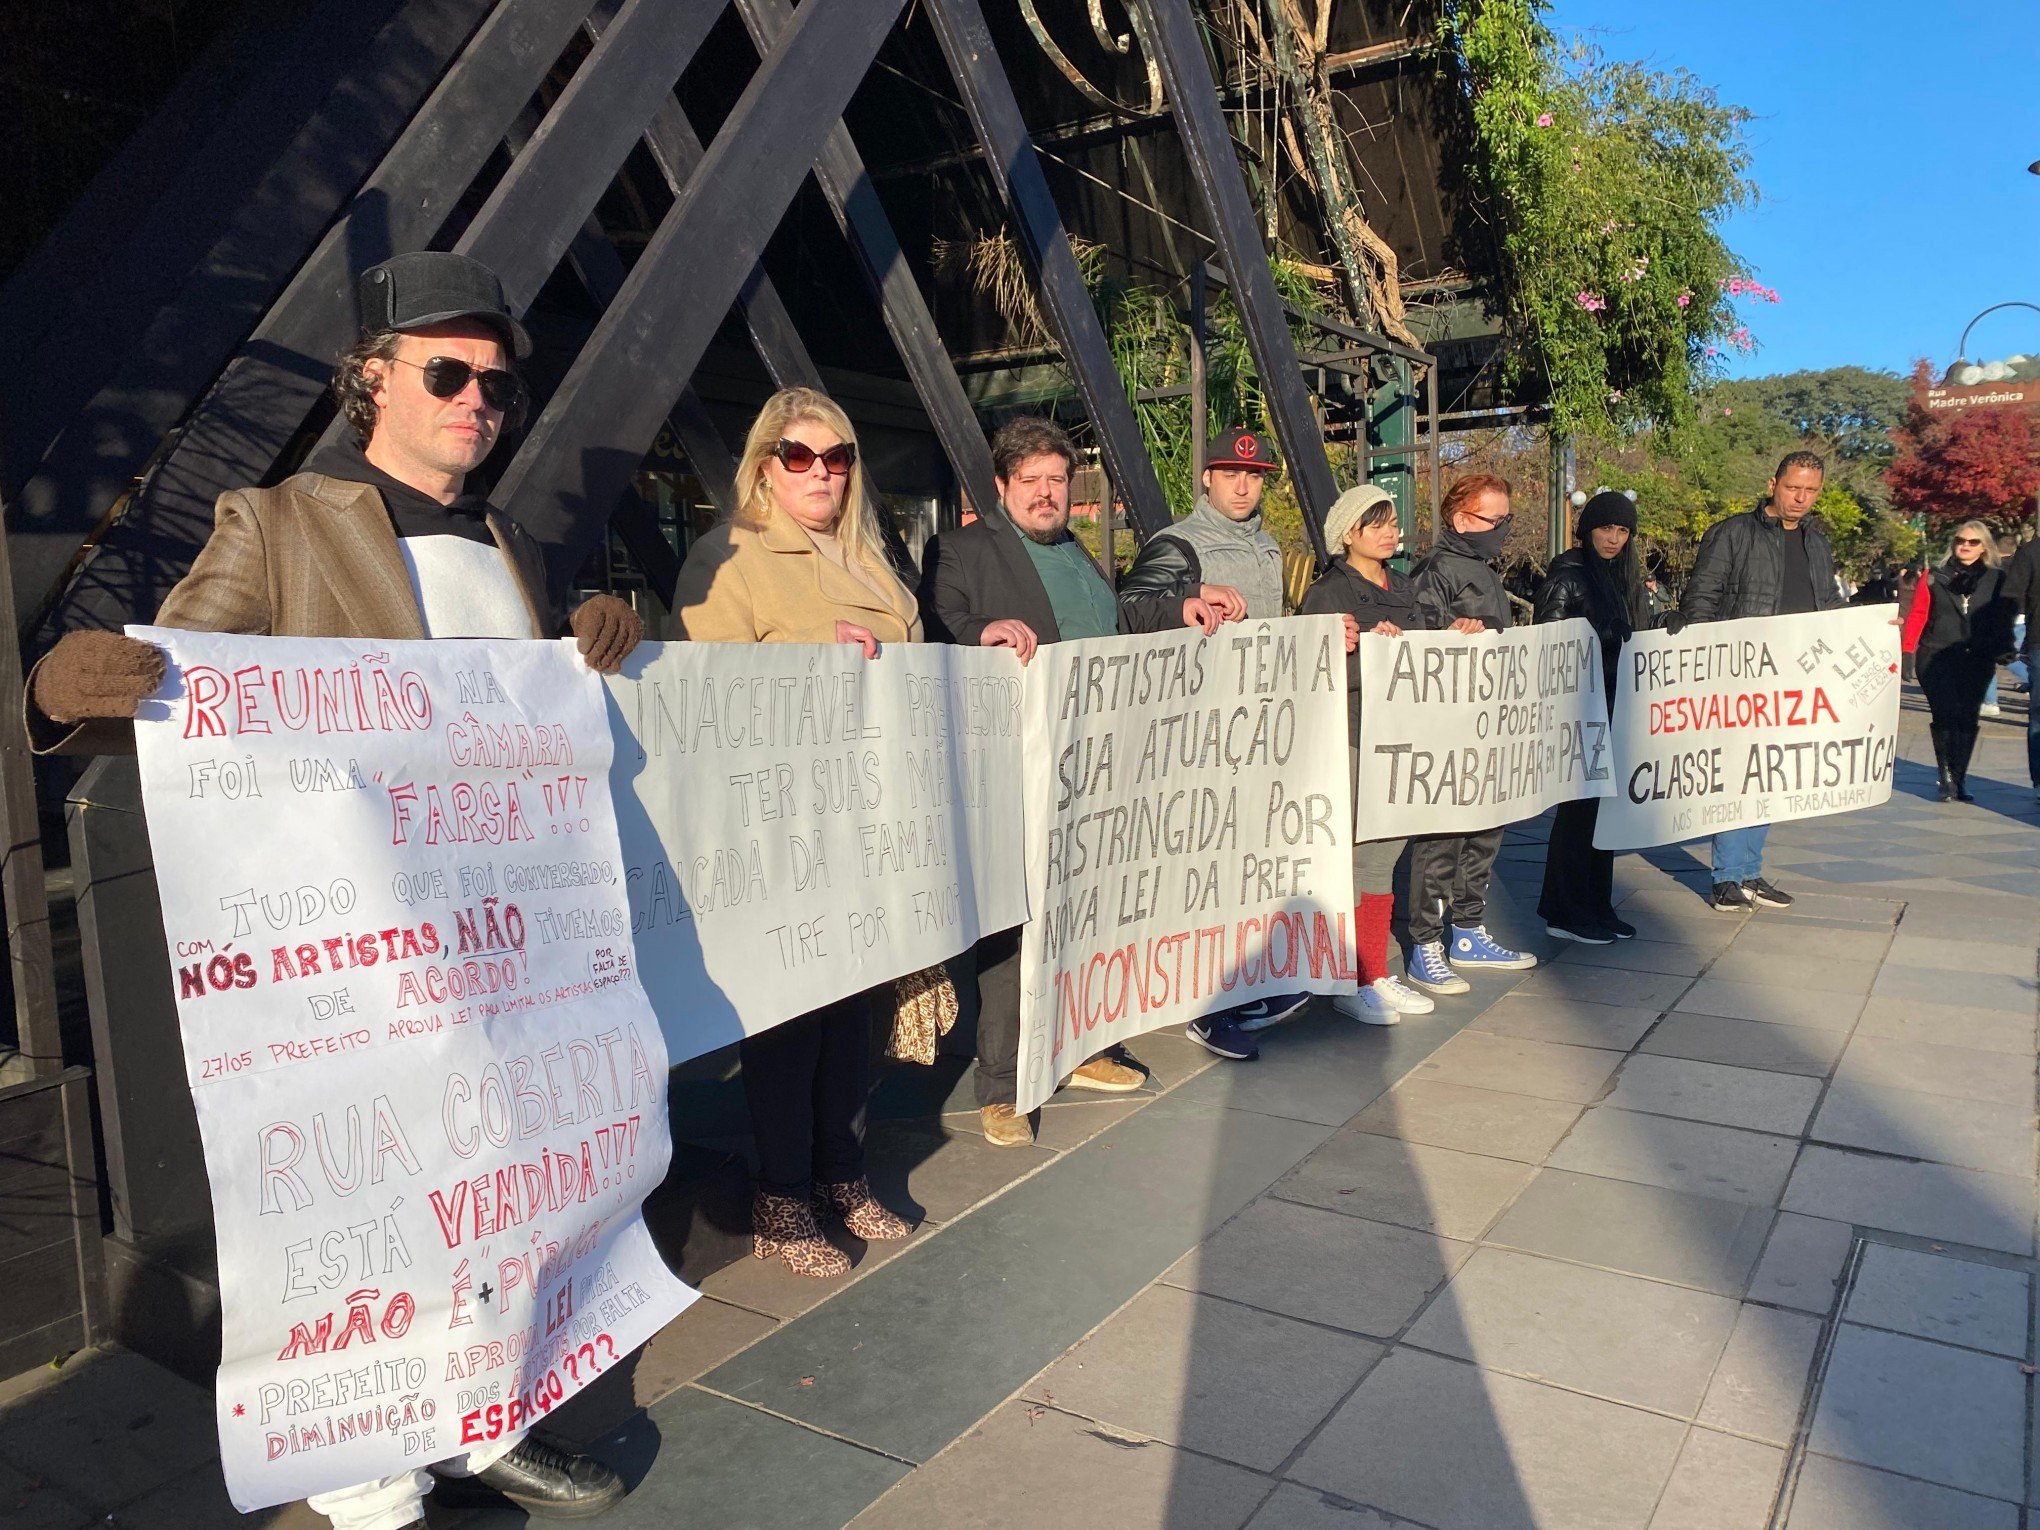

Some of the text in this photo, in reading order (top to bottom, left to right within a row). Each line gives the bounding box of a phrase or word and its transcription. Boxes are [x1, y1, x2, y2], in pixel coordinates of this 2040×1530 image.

[1928, 389, 1946, 397] Rua
[1929, 391, 2023, 408] Madre Verônica
[183, 651, 506, 739] REUNIÃO NA
[1061, 621, 1336, 721] ARTISTAS TÊM A
[1386, 636, 1595, 704] ARTISTAS QUEREM
[1634, 636, 1875, 692] PREFEITURA EM LEI
[447, 711, 574, 770] CÂMARA
[637, 656, 882, 760] INACEITÁVEL
[1476, 701, 1555, 740] O PODER DE
[1650, 687, 1840, 735] DESVALORIZA
[189, 753, 262, 800] FOI
[289, 758, 366, 792] UMA
[730, 762, 797, 827] TER
[812, 750, 882, 815] SUAS
[1057, 697, 1296, 812] SUA ATUAÇÃO
[1374, 738, 1544, 806] TRABALHAR
[1559, 720, 1610, 783] PAZ
[1628, 723, 1895, 804] CLASSE ARTISTÍCA
[1047, 780, 1337, 890] RESTRINGIDA POR
[1673, 808, 1692, 833] NOS
[1702, 800, 1743, 826] IMPEDEM
[1756, 798, 1770, 819] DE
[220, 878, 356, 938] TUDO
[392, 868, 448, 906] QUE
[458, 862, 497, 898] FOI
[626, 839, 768, 935] CALÇADA
[789, 829, 832, 893] DA
[1042, 853, 1313, 964] NOVA LEI DA PREF.
[177, 939, 215, 957] COM
[178, 942, 258, 1000] NÓS
[453, 897, 526, 954] NÃO
[534, 906, 624, 945] TIVEMOS
[593, 955, 627, 974] FALTA DE
[766, 882, 962, 970] TIRE POR FAVOR
[202, 1050, 252, 1079] 27/05
[267, 1029, 371, 1063] PREFEITO
[388, 1014, 444, 1040] APROVA
[451, 1006, 472, 1025] LEI
[539, 990, 551, 1005] OS
[555, 981, 594, 1001] ARTISTAS
[307, 987, 355, 1020] DE
[1051, 910, 1358, 1066] INCONSTITUCIONAL
[258, 1022, 657, 1216] RUA COBERTA
[282, 1195, 413, 1305] ESTÁ
[259, 1357, 427, 1425] PREFEITO
[445, 1323, 540, 1382] APROVA
[545, 1277, 573, 1338] LEI
[278, 1288, 415, 1361] NÃO
[448, 1258, 474, 1330] É
[266, 1392, 436, 1462] DIMINUIÇÃO
[457, 1381, 500, 1414] DOS
[572, 1311, 602, 1346] POR
[600, 1281, 651, 1328] FALTA
[403, 1425, 437, 1457] DE
